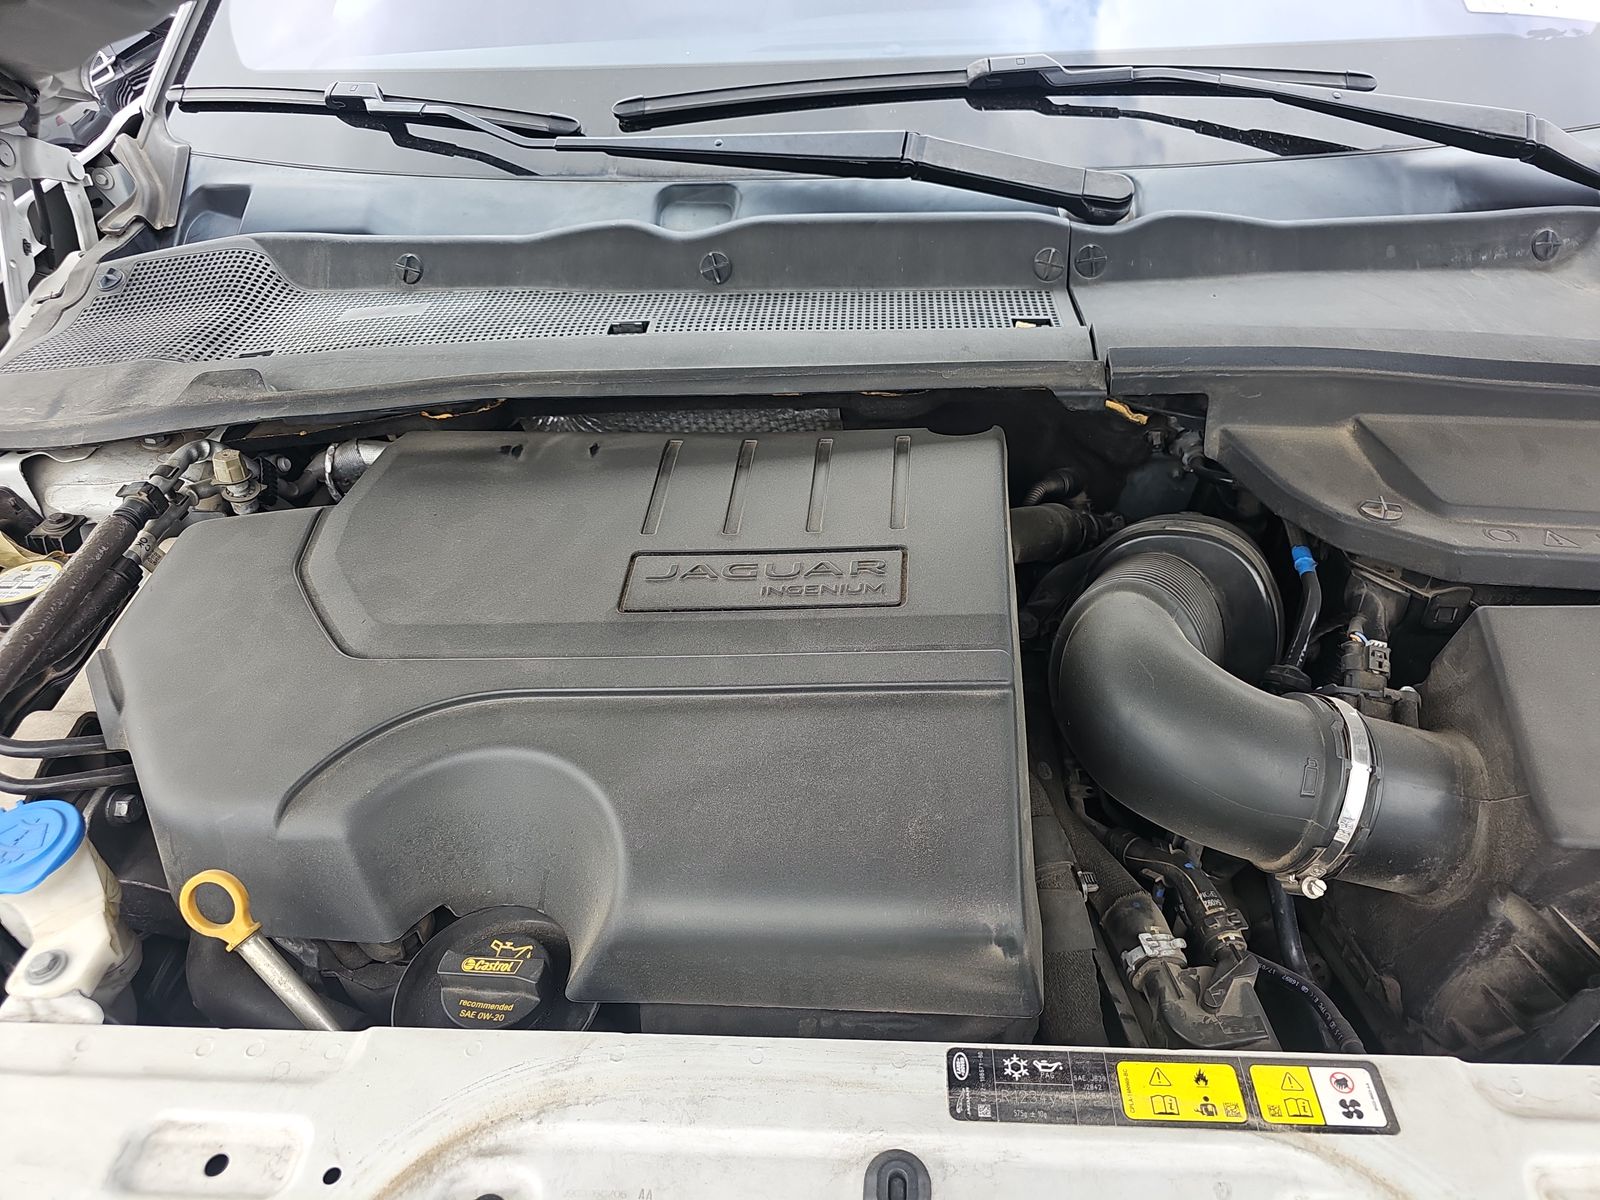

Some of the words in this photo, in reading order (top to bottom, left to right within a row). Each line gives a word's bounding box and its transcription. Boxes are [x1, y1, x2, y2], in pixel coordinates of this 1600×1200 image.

[645, 559, 887, 581] JAGUAR
[760, 583, 885, 597] INGENIUM
[474, 959, 514, 972] Castrol
[459, 999, 515, 1011] recommended
[459, 1009, 476, 1018] SAE
[477, 1012, 505, 1022] 0W-20
[1073, 1074, 1086, 1082] SAE
